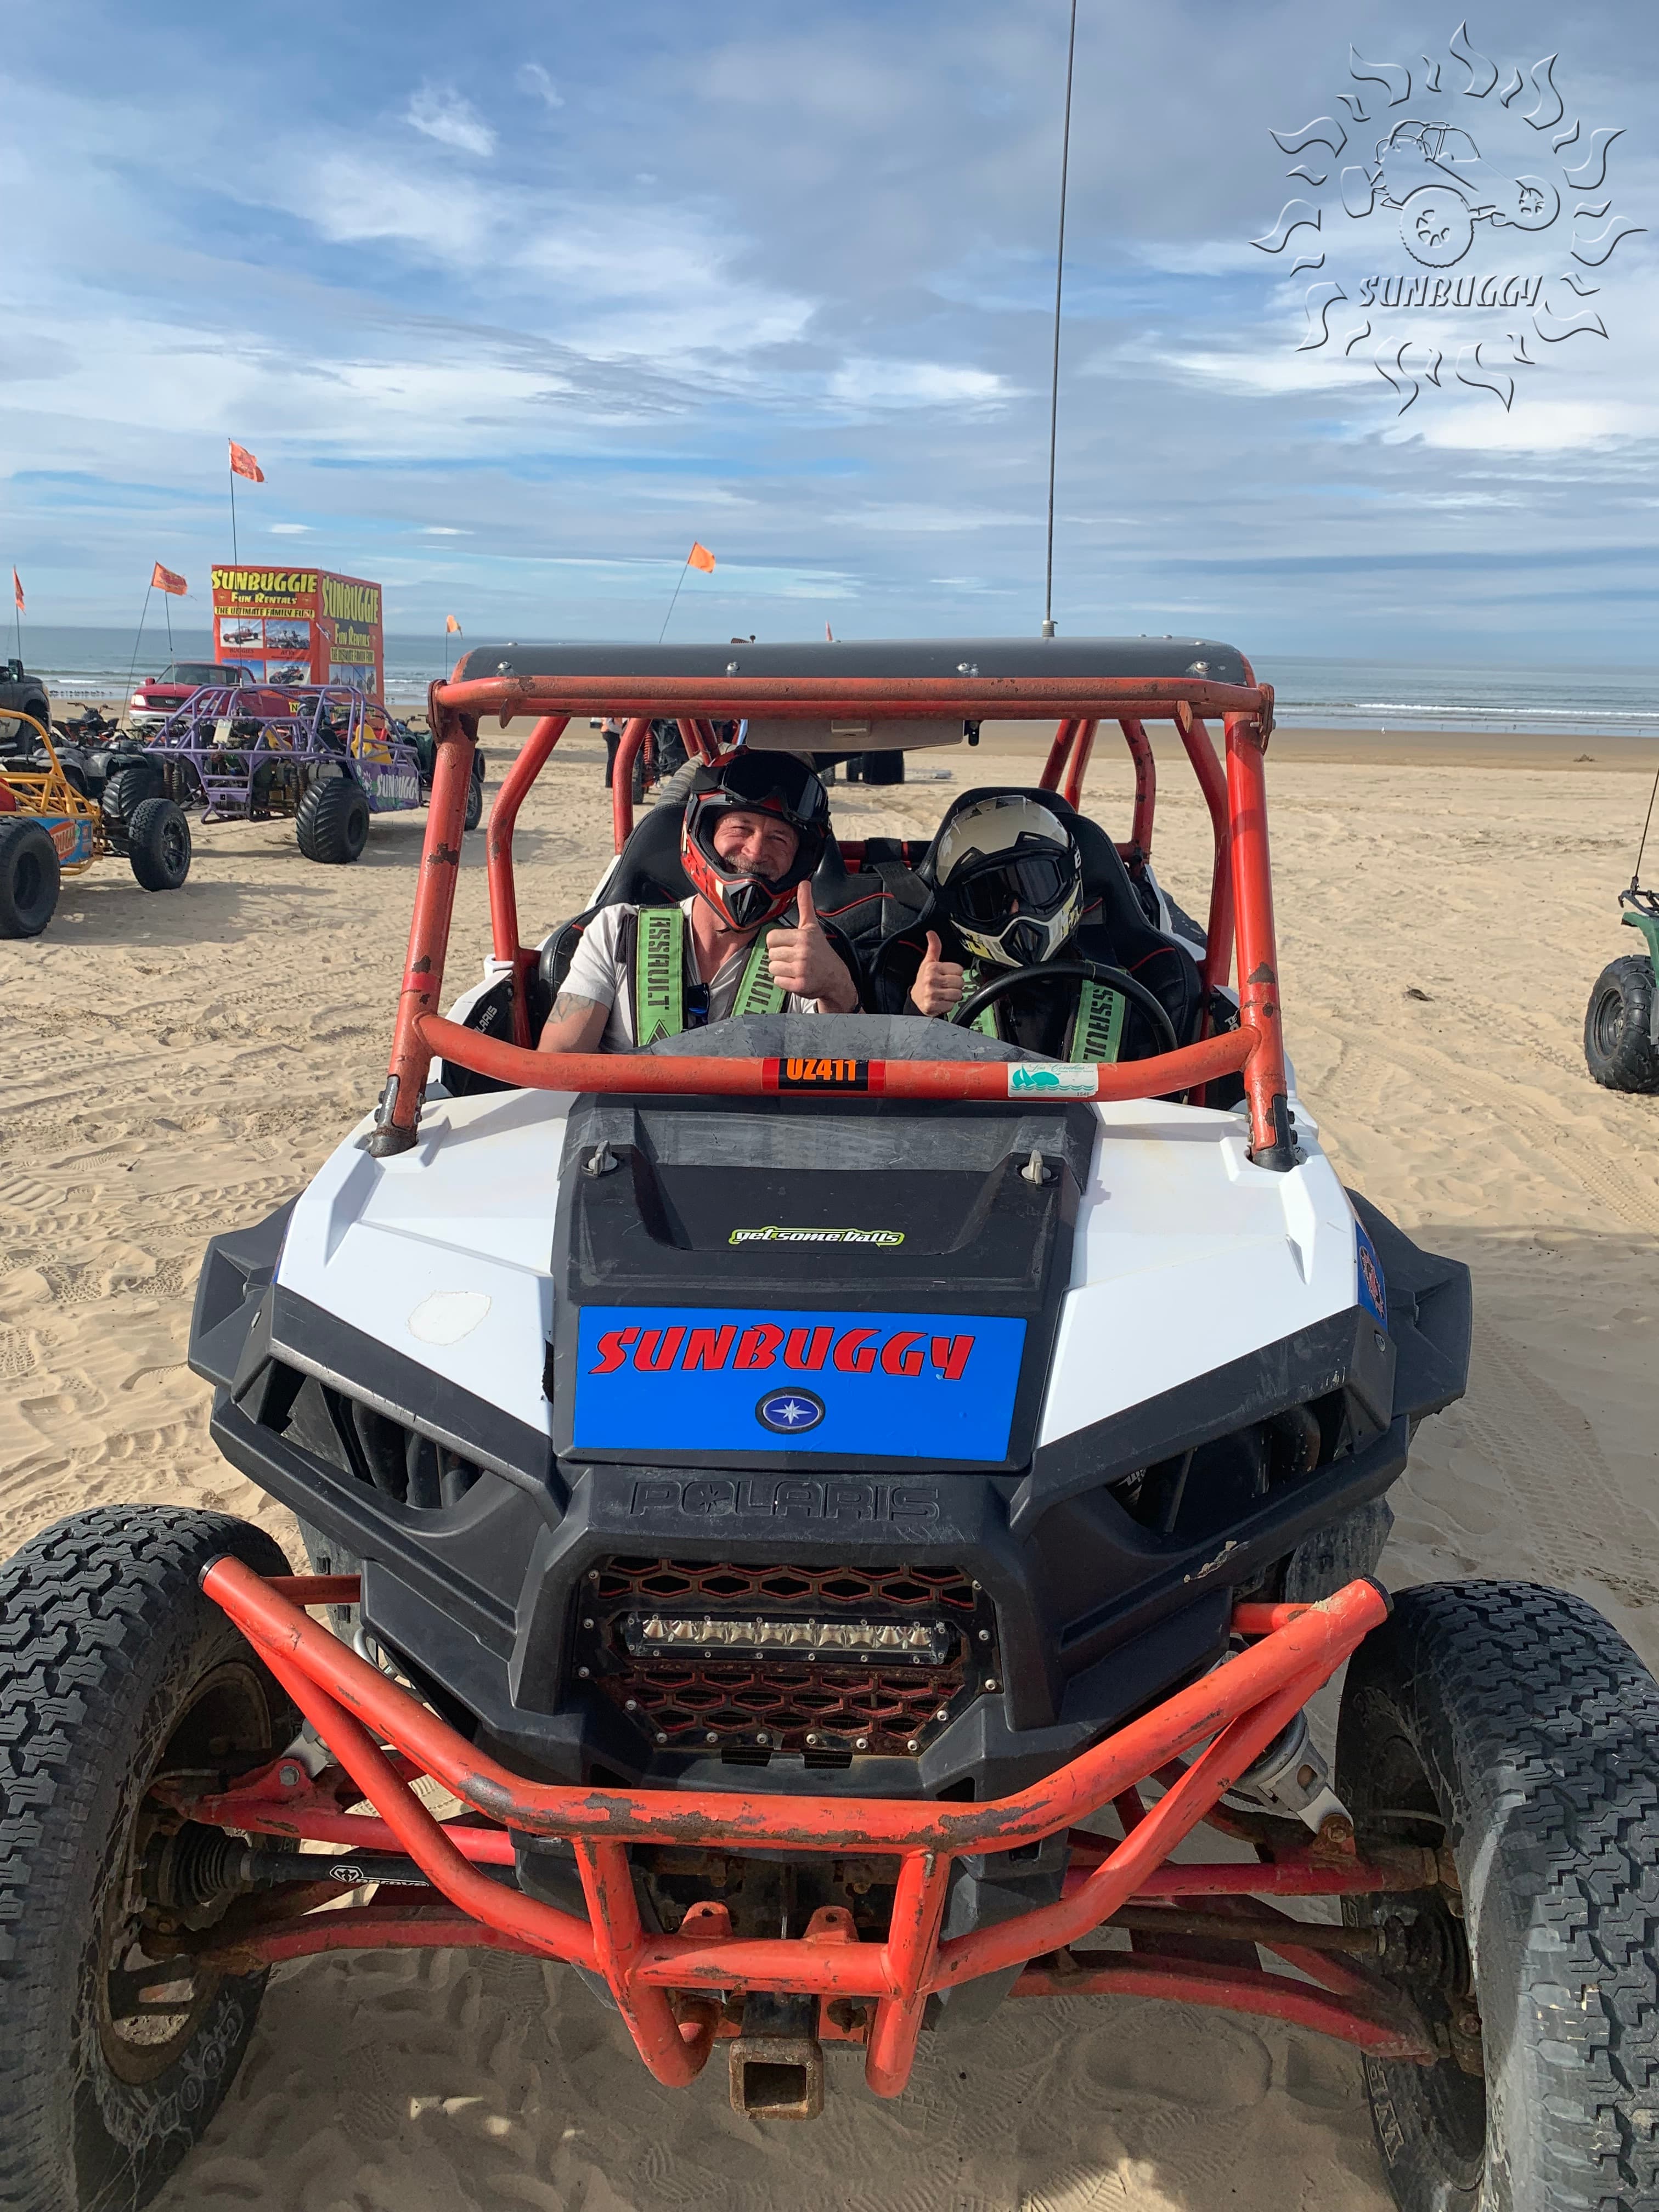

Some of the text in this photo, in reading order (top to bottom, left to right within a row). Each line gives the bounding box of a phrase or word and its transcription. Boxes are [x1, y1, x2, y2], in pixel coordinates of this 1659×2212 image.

[211, 569, 318, 592] SUNBUGGIE
[322, 576, 379, 624] SUNBUGGIE
[230, 607, 264, 616] ULTIMATE
[266, 608, 292, 617] FAMILY
[647, 917, 671, 1010] ASSAULT
[474, 1005, 498, 1033] LARIS
[1082, 987, 1114, 1063] SSAUL
[588, 1323, 975, 1380] SUNBUGGY
[629, 1480, 940, 1522] POLARIS
